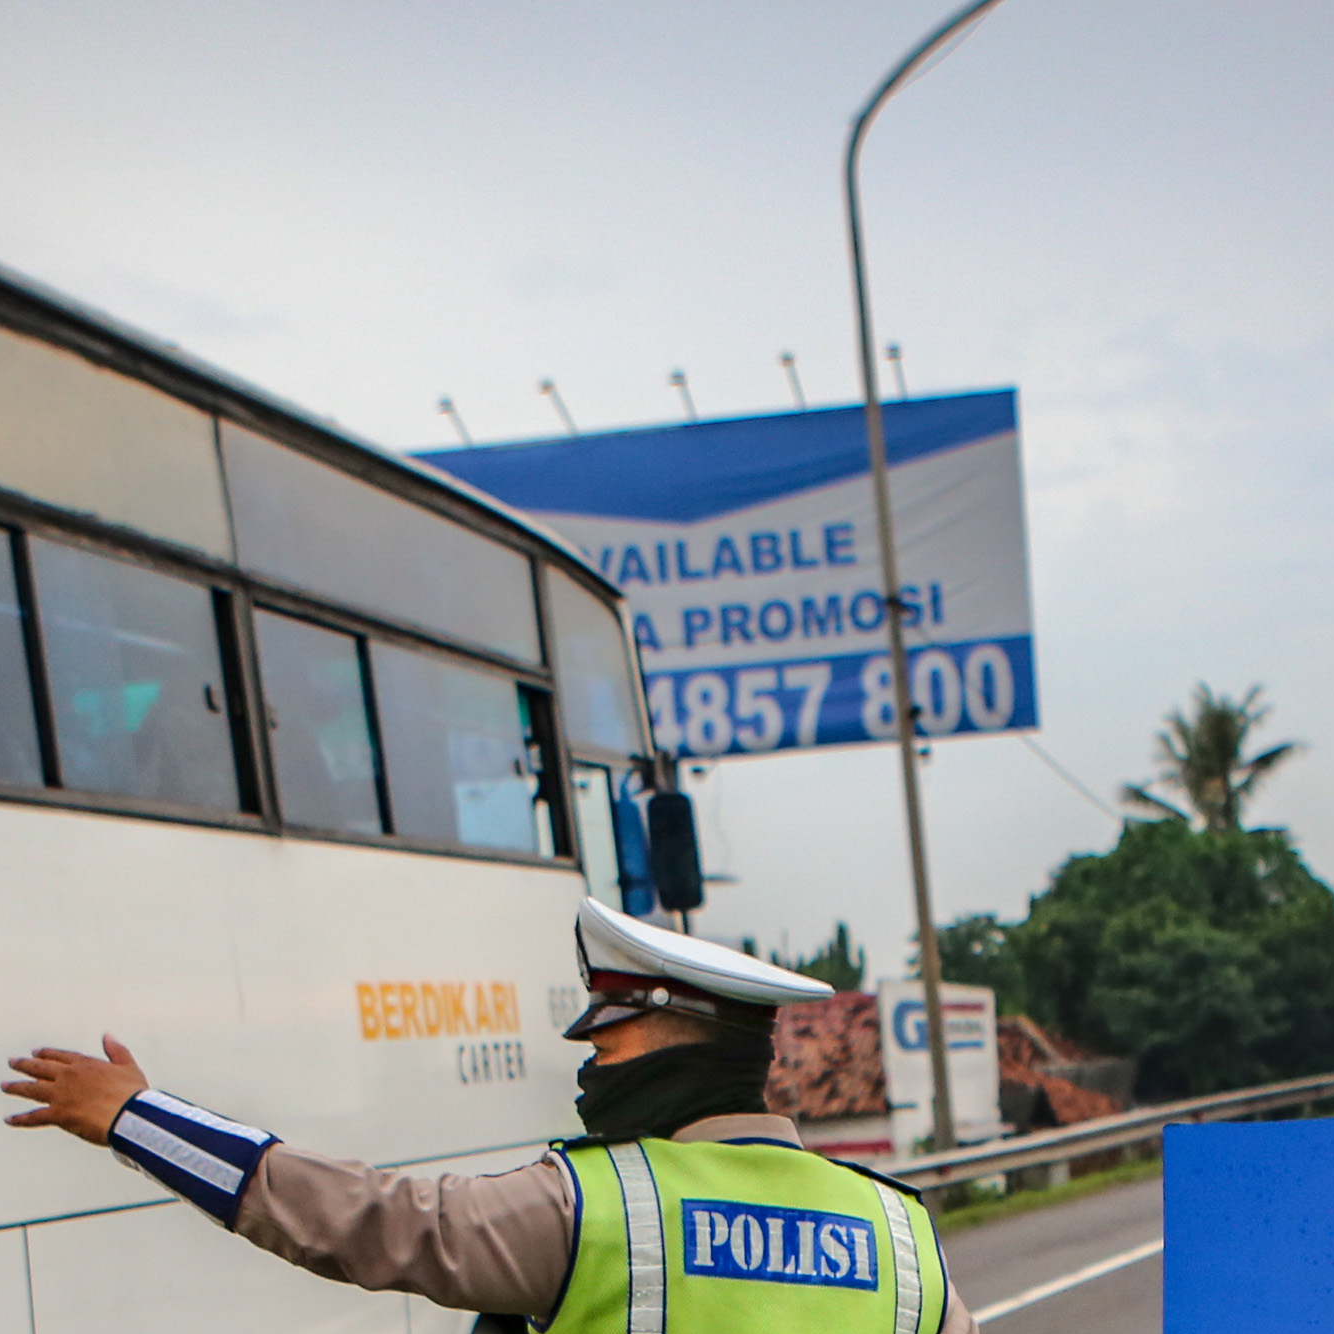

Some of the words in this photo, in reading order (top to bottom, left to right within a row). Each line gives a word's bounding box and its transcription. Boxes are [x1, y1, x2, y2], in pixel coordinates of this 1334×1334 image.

[683, 582, 944, 648] PROMOSI
[861, 648, 1014, 742] 800
[356, 982, 520, 1039] BERDIKARI
[458, 1041, 526, 1084] CARTER
[692, 1210, 873, 1282] POLISI
